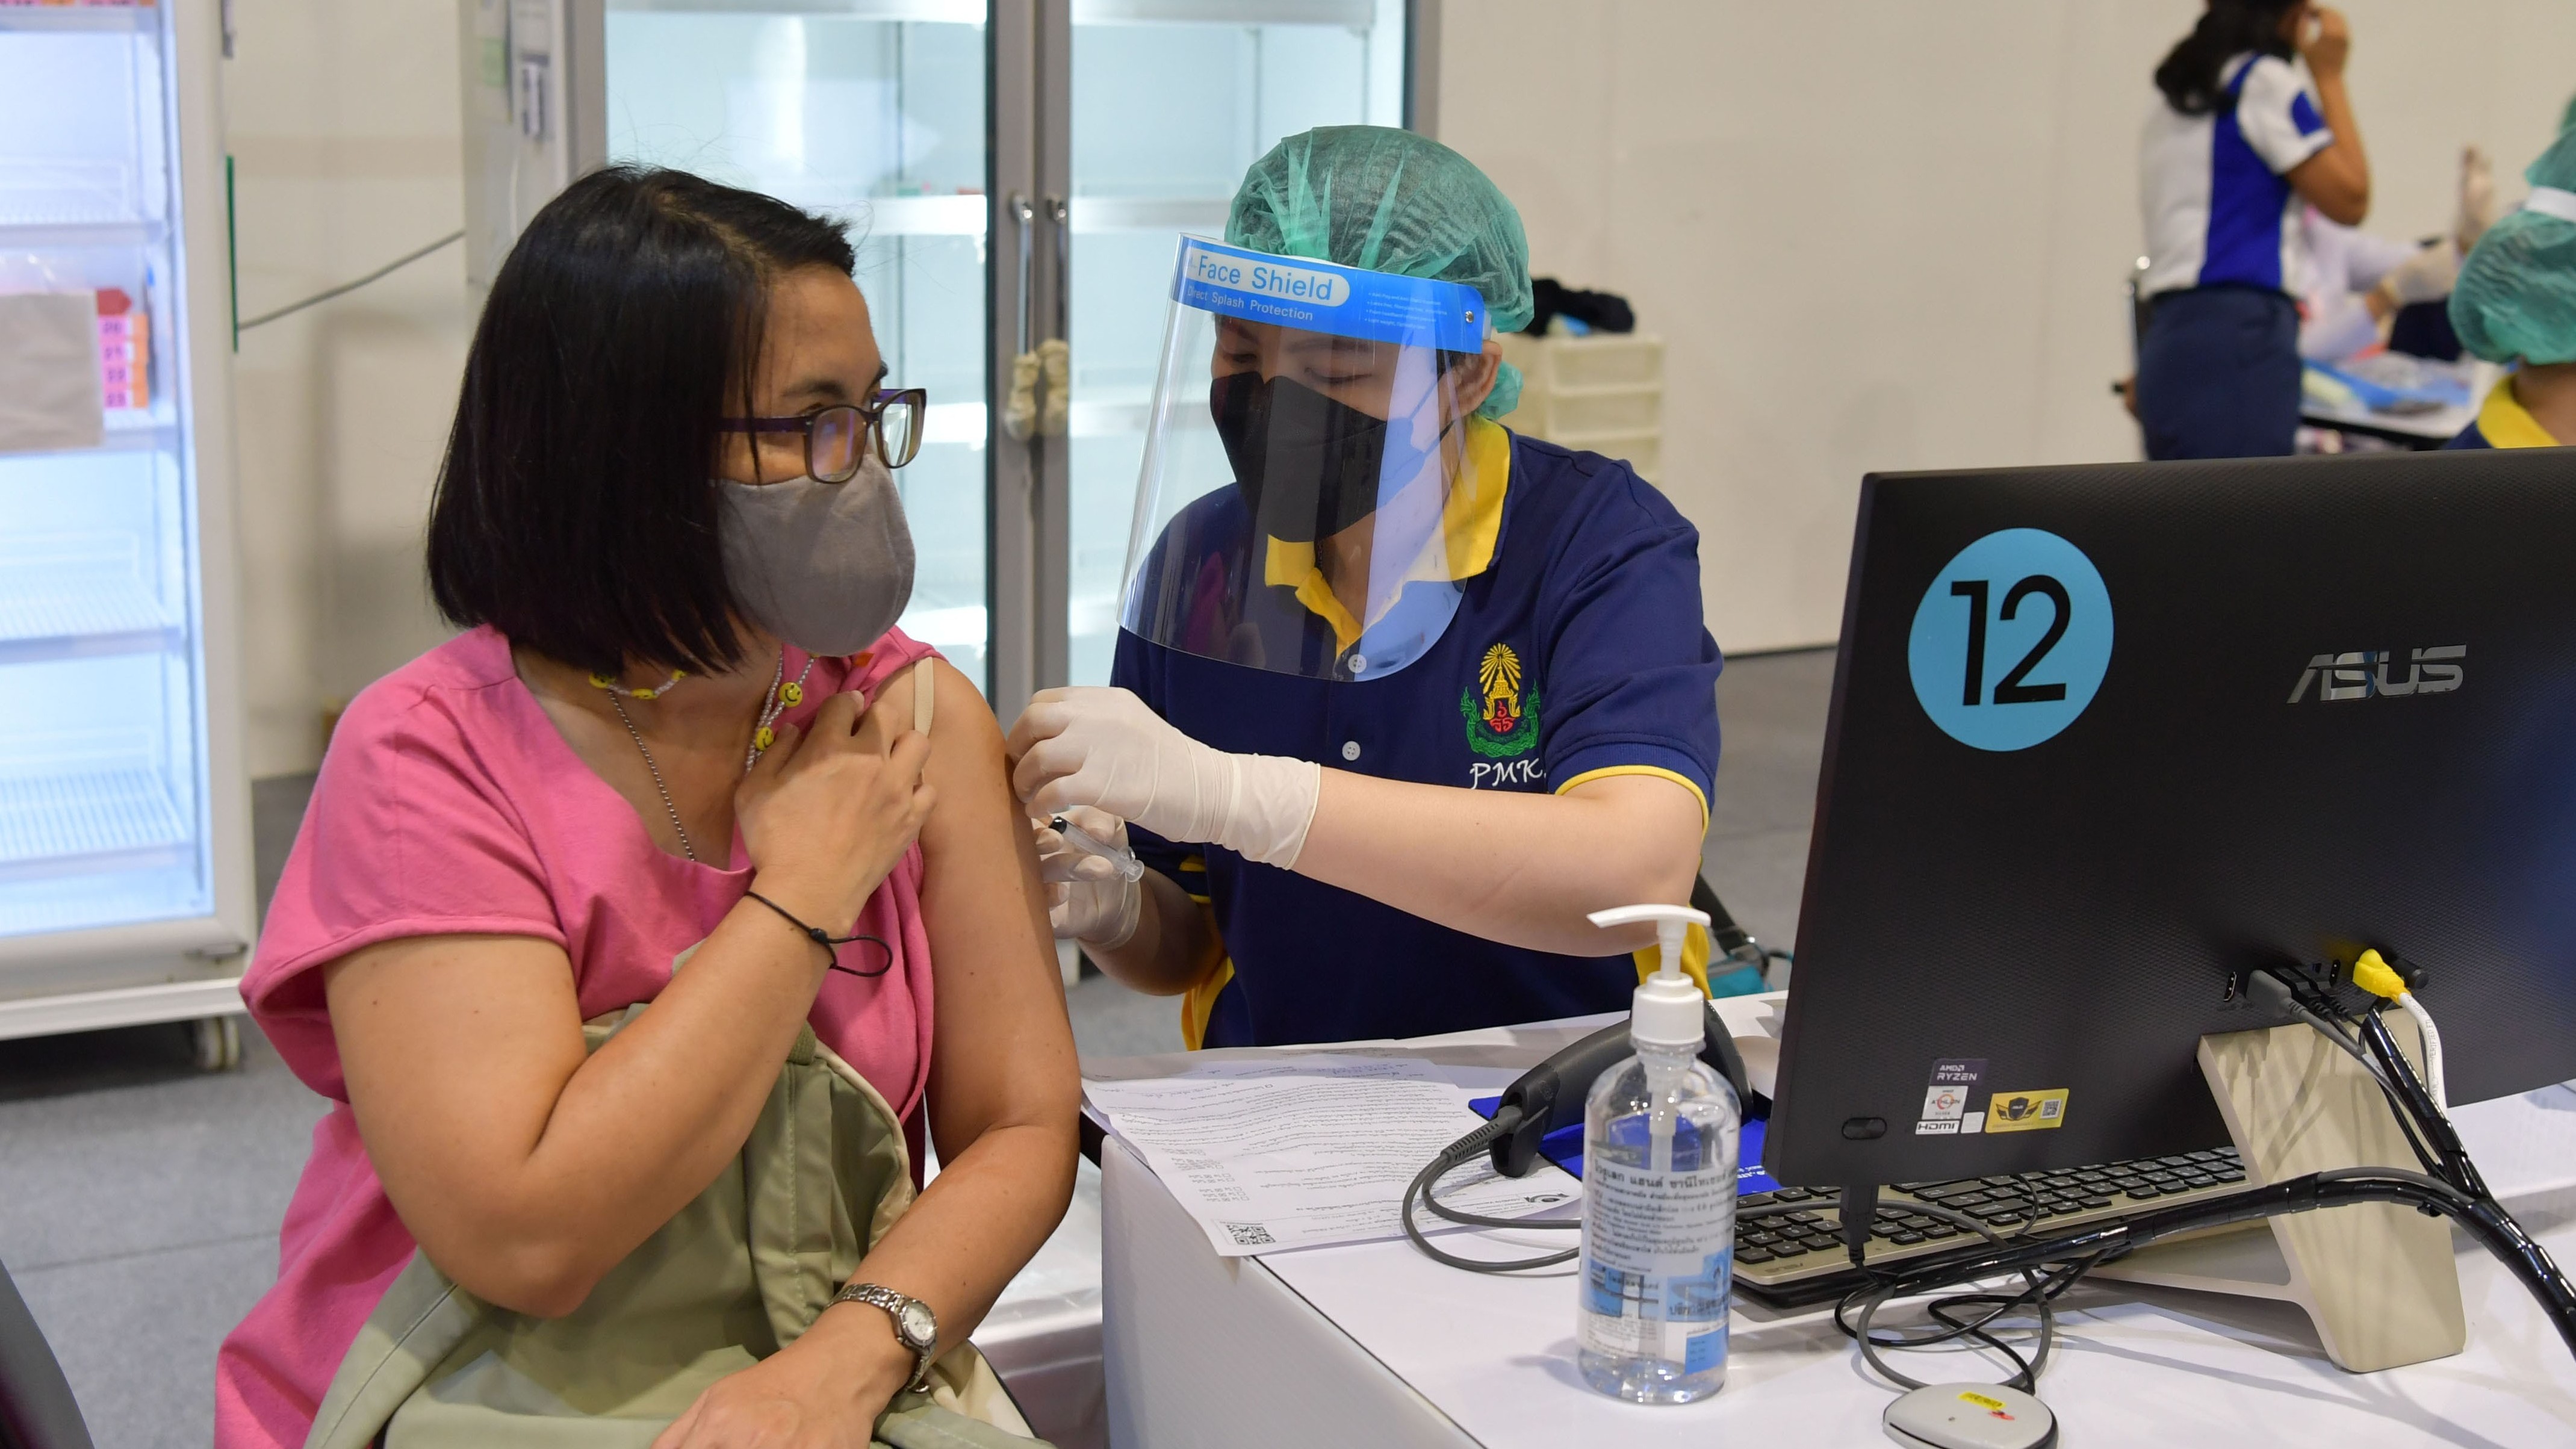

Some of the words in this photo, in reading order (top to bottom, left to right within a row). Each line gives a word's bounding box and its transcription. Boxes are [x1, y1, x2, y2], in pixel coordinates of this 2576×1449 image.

[1198, 255, 1241, 285] Face
[1252, 266, 1333, 300] Shield
[1187, 285, 1208, 300] Direct
[1212, 292, 1244, 309] Splash
[1250, 300, 1313, 321] Protection
[1950, 574, 2071, 706] 12
[2286, 645, 2466, 704] ASUS
[1470, 757, 1547, 790] PMK
[1937, 1072, 1978, 1081] RYZEN
